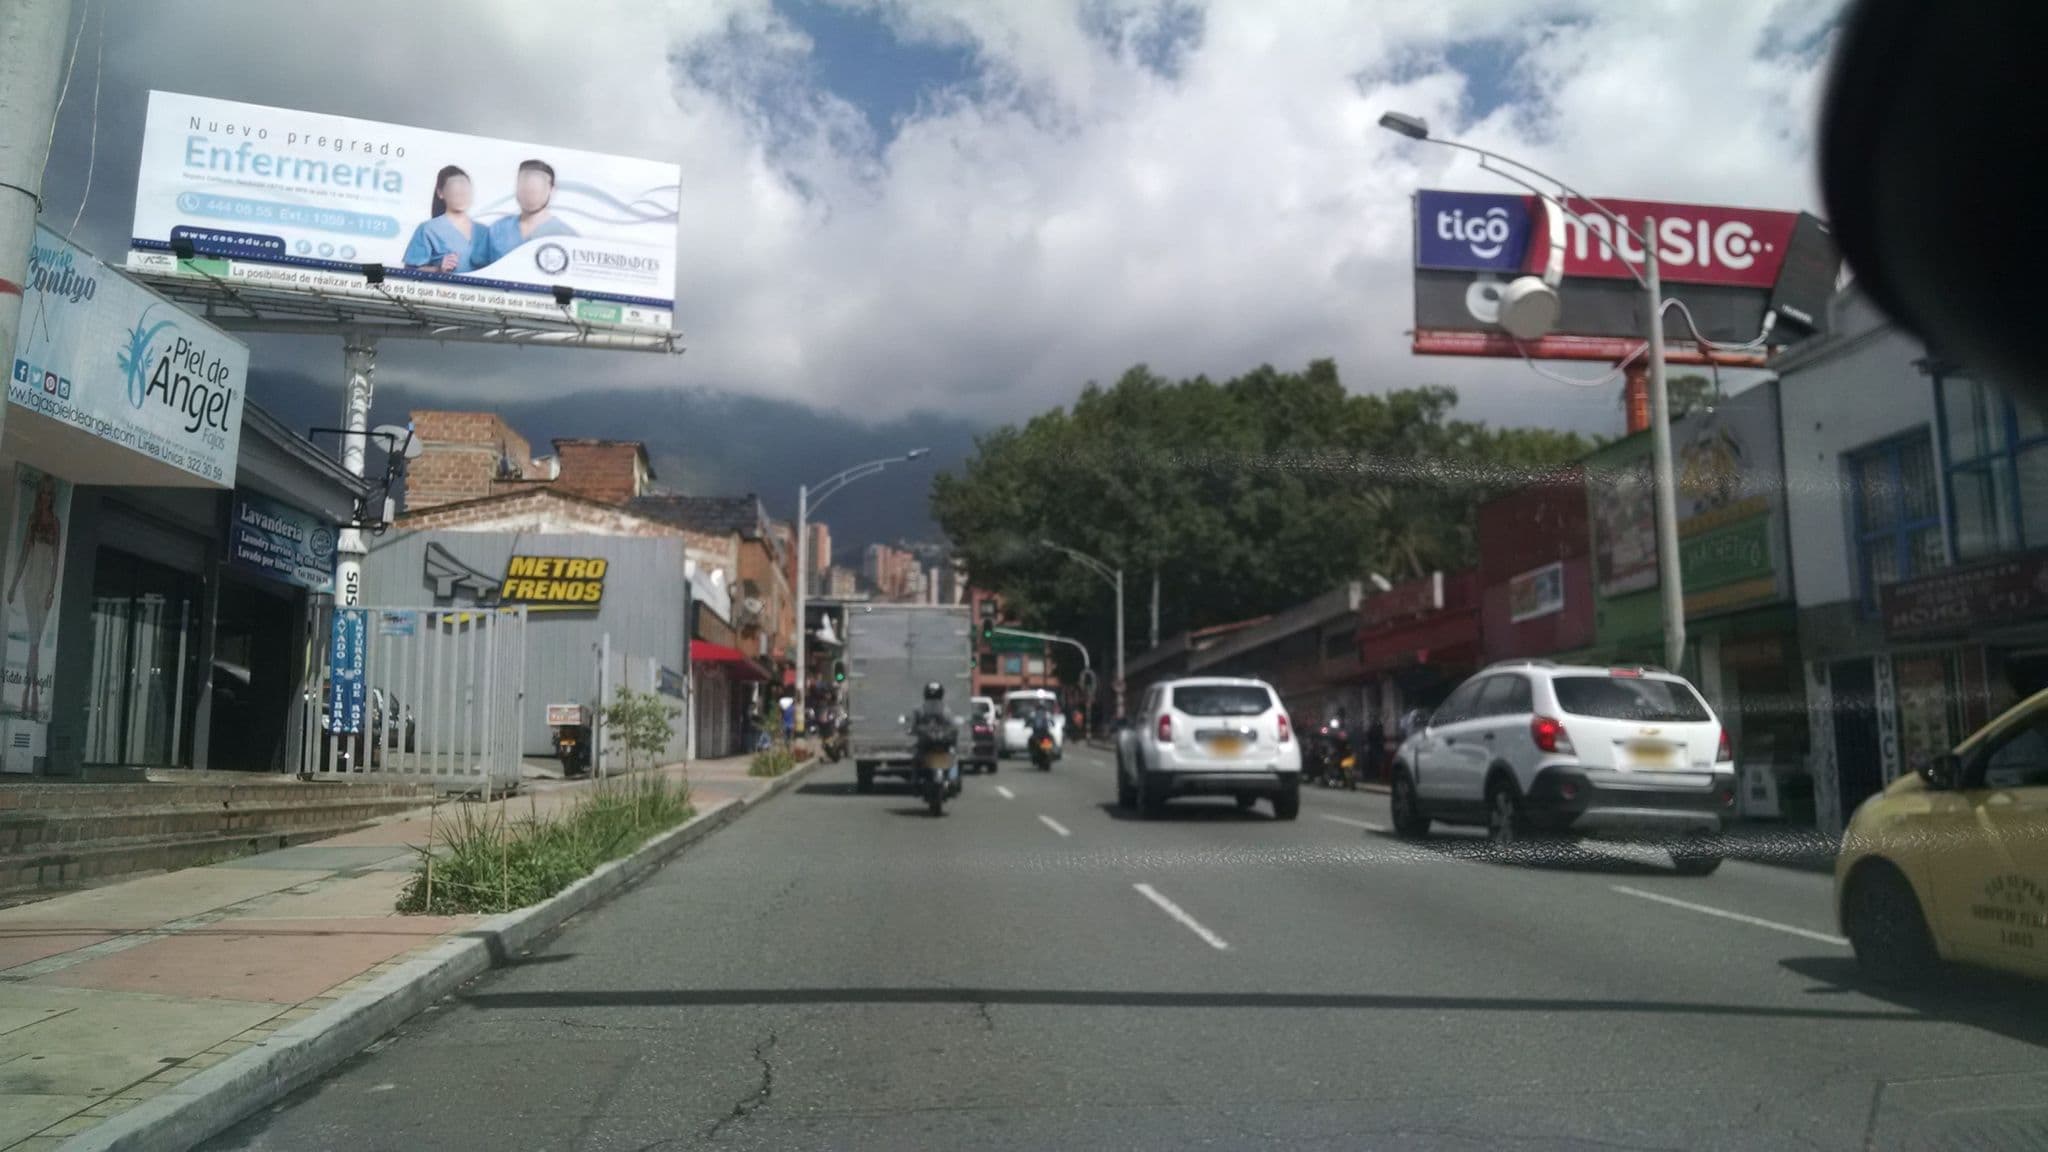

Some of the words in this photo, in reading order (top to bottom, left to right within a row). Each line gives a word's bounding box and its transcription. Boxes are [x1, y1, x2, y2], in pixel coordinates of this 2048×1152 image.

[190, 116, 268, 140] Nuevo
[287, 131, 406, 158] pregrado
[184, 135, 405, 194] Enfermería
[178, 229, 280, 250] www.ces.edu.co
[232, 267, 244, 277] La
[299, 273, 311, 284] de
[172, 336, 206, 378] Piel
[208, 357, 229, 389] de
[145, 344, 233, 434] Ángel
[202, 428, 225, 451] Fajas
[186, 454, 202, 472] 322
[213, 465, 223, 480] 59
[507, 555, 607, 579] METRO
[500, 578, 604, 602] FRENOS
[350, 703, 362, 734] ROPA
